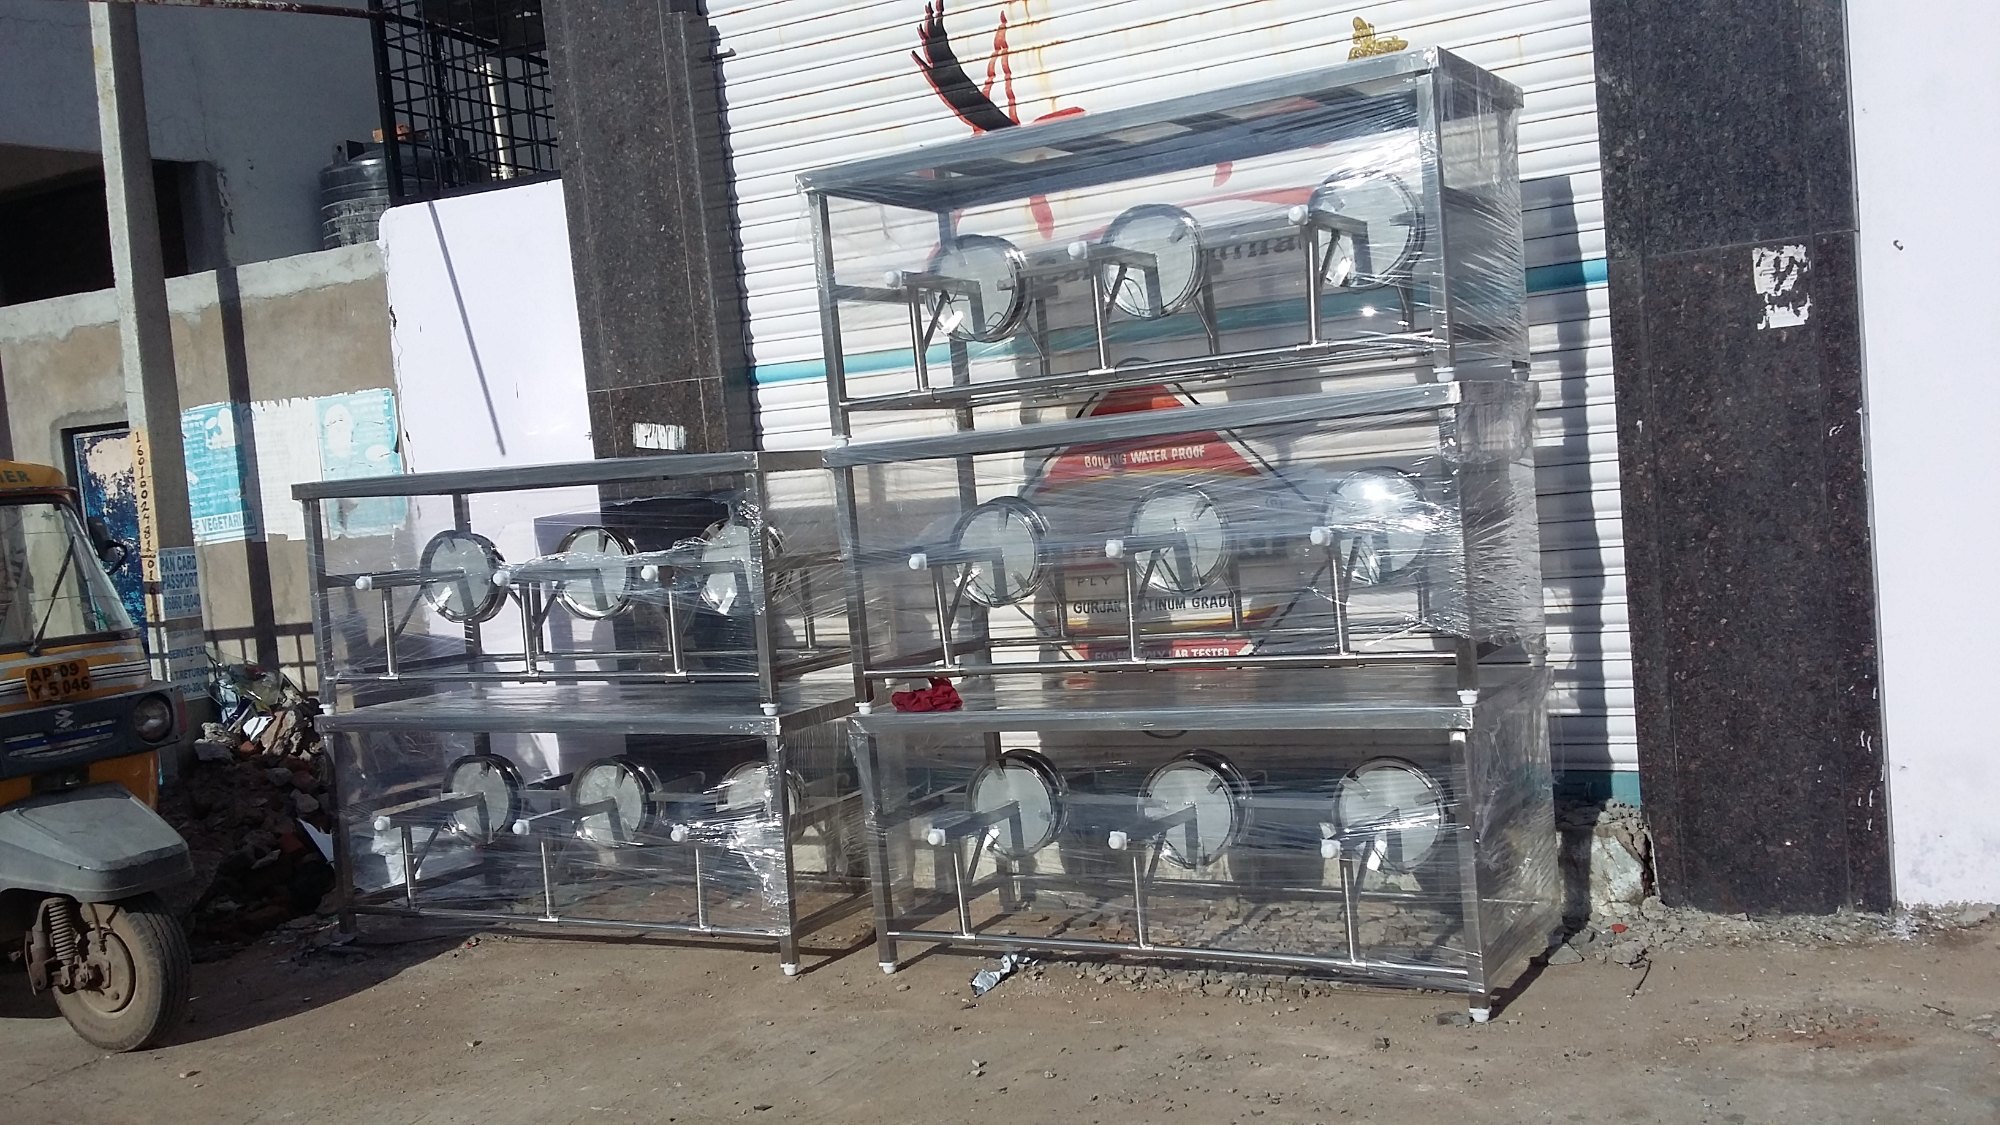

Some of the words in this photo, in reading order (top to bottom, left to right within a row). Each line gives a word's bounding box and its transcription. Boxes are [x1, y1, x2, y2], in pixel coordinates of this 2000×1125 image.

[1084, 454, 1126, 468] BOILING
[1130, 449, 1167, 464] WATER
[1171, 446, 1205, 460] PROOF
[201, 511, 254, 532] VEGETARIAN
[160, 557, 176, 572] PAN
[177, 554, 197, 571] CARD
[162, 571, 198, 590] PASSPORT
[1077, 576, 1111, 587] PLY
[1073, 600, 1122, 614] GURJAN
[30, 667, 52, 684] AP
[59, 662, 79, 678] 09
[30, 685, 42, 699] Y
[48, 676, 90, 697] 5046
